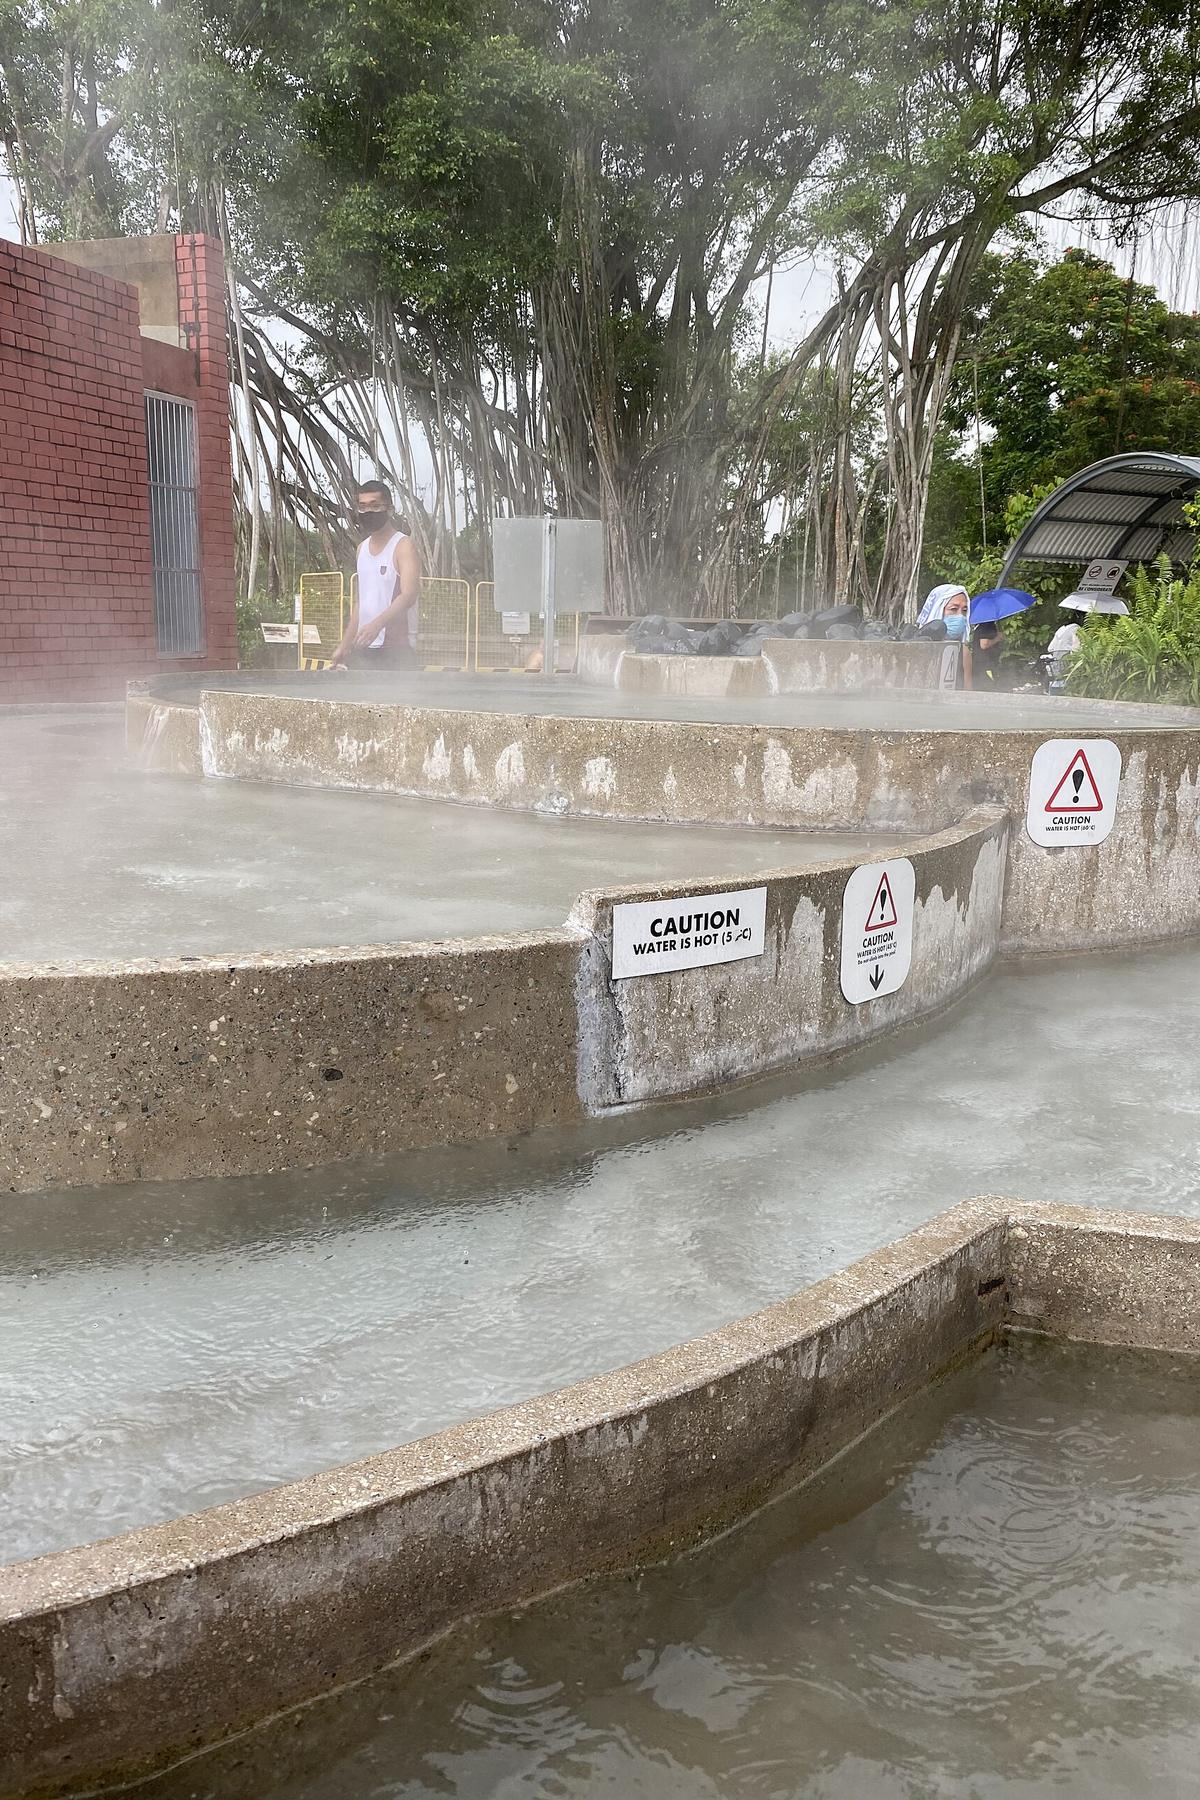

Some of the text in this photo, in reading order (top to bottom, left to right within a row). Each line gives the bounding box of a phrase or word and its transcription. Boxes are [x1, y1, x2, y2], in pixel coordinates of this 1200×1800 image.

[1052, 816, 1091, 824] CAUTION
[650, 908, 740, 937] CAUTION
[633, 939, 677, 955] WATER
[680, 937, 691, 949] IS
[694, 933, 719, 948] HOT
[862, 931, 894, 948] CAUTION
[857, 949, 872, 958] WATER
[877, 945, 886, 953] HOT
